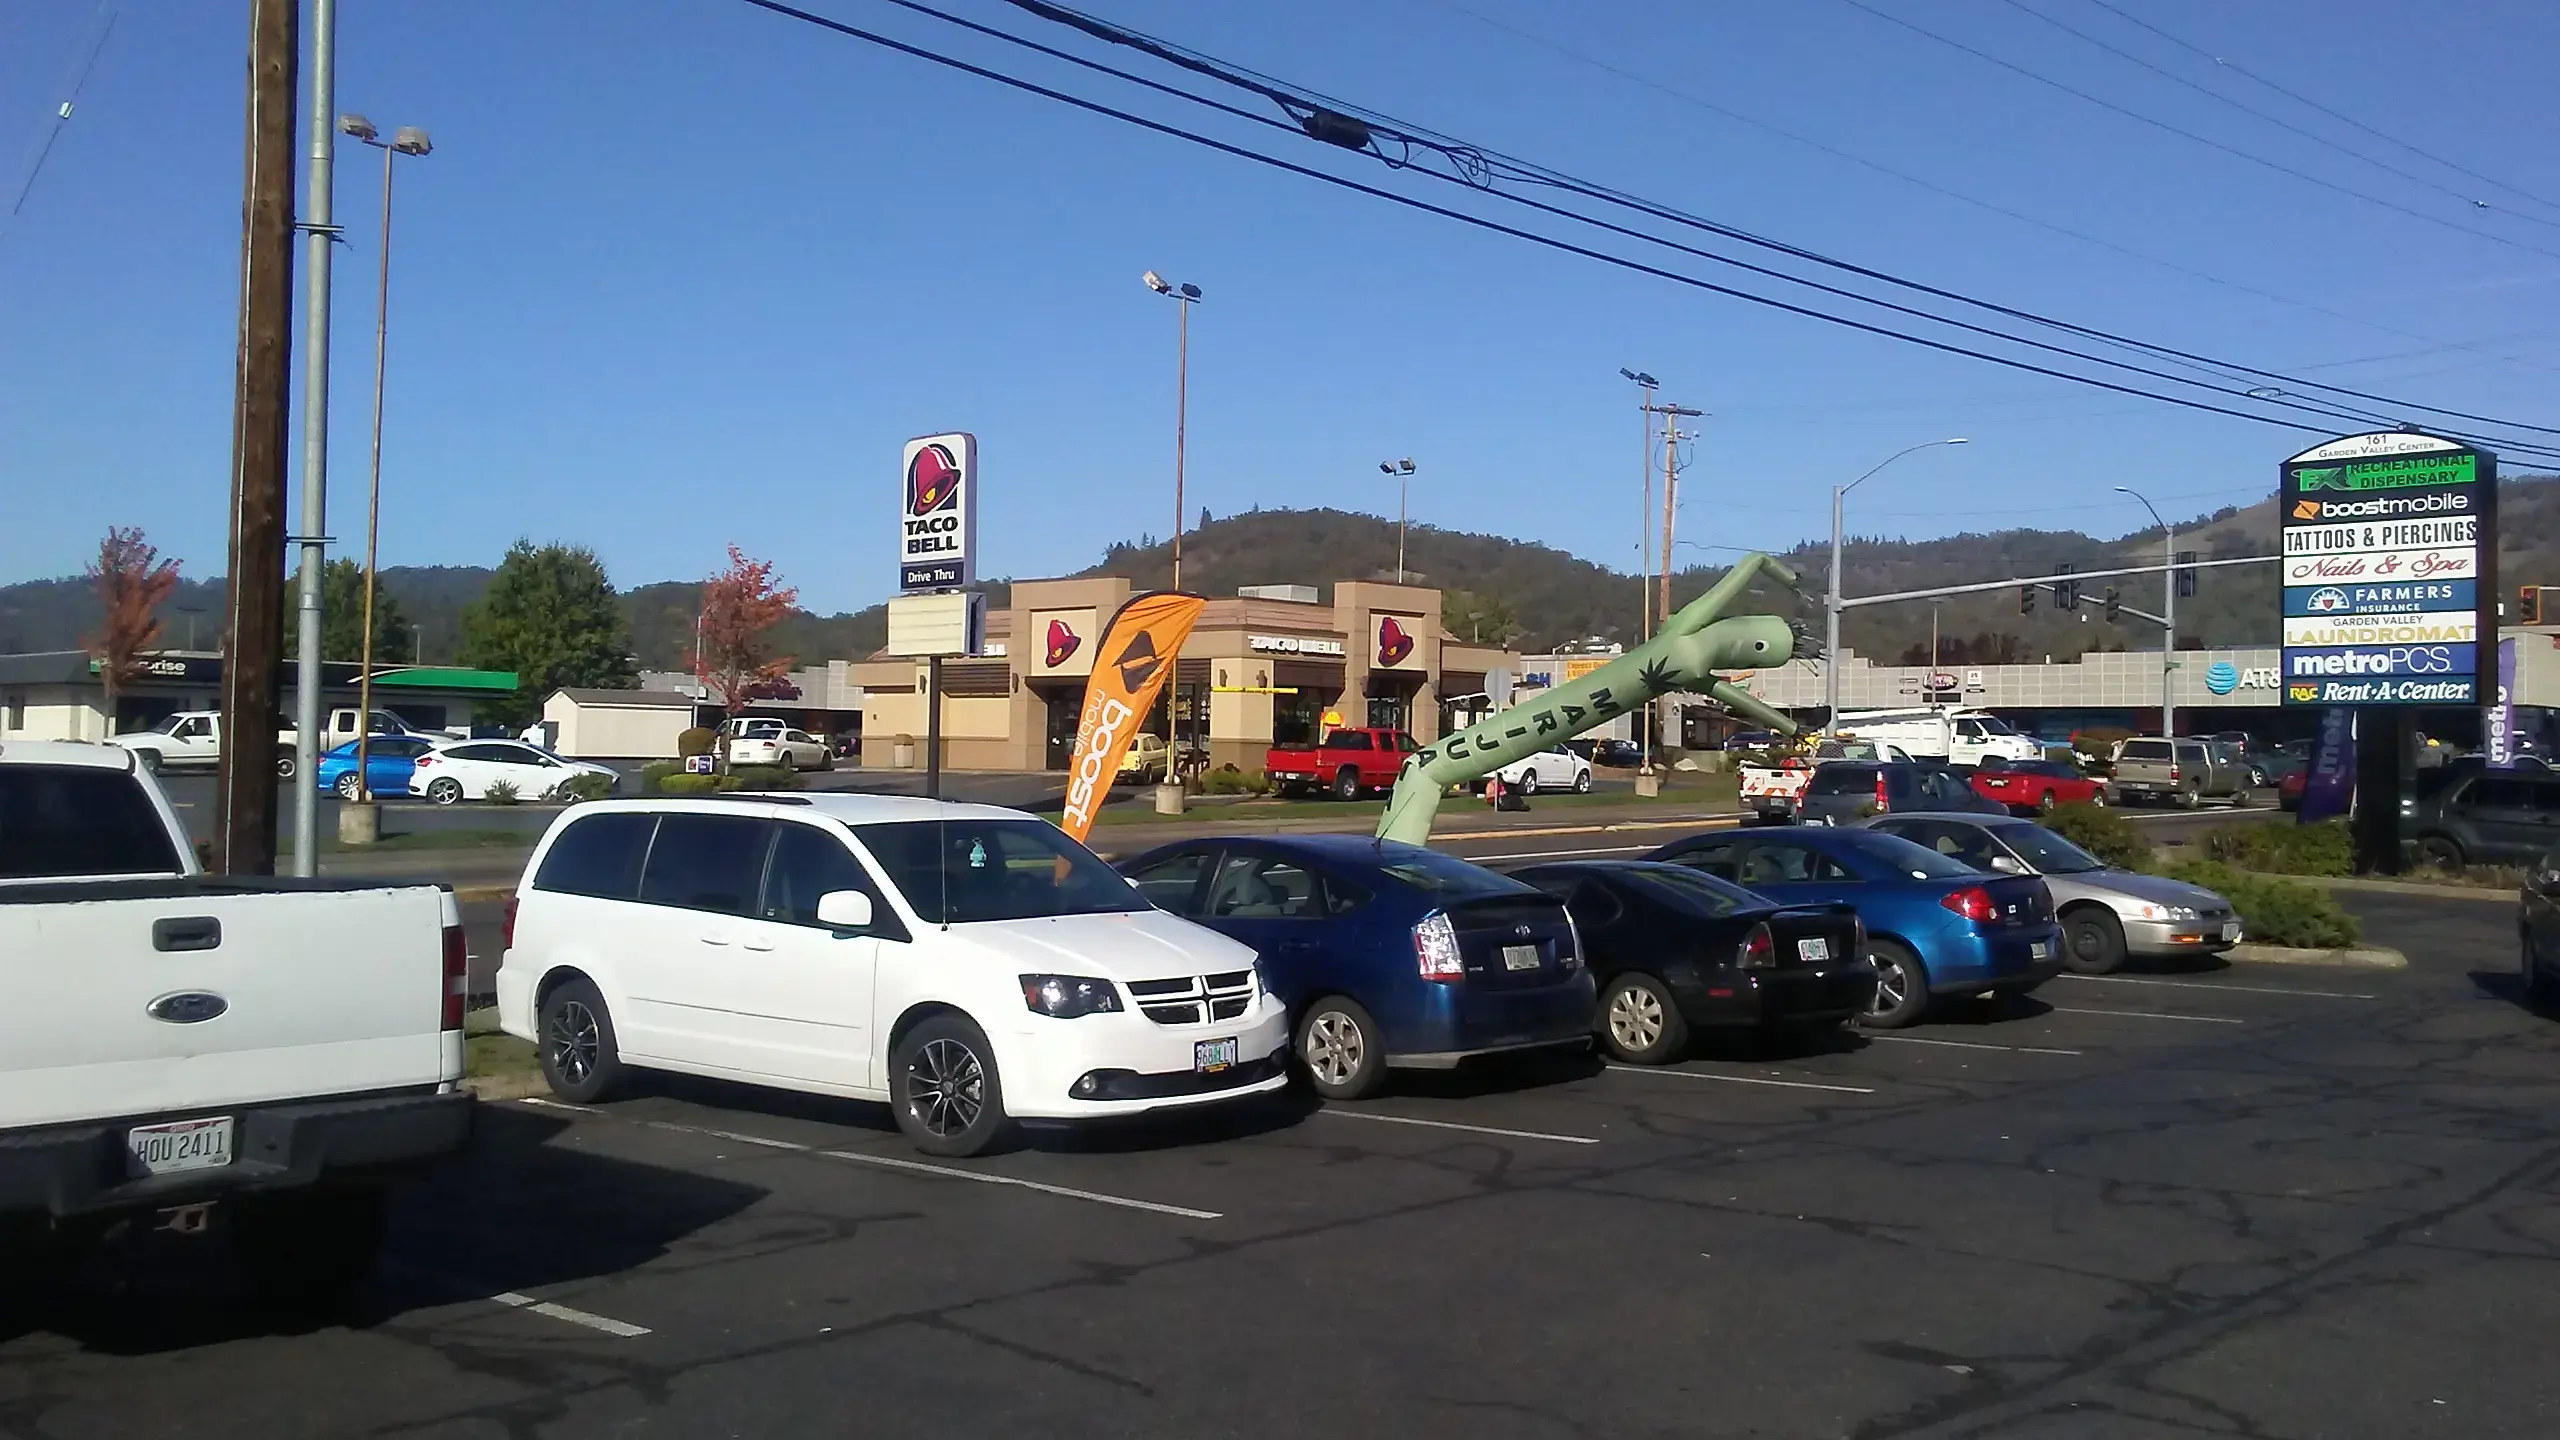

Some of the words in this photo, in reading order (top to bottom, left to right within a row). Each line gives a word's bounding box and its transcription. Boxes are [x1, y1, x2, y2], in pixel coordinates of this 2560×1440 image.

[2366, 434, 2387, 444] 161
[2350, 456, 2470, 475] RECREATIONAL
[2360, 470, 2459, 489] DISPENSARY
[904, 516, 959, 536] TACO
[907, 535, 959, 554] BELL
[2286, 530, 2355, 551] TATTOOS
[2363, 527, 2374, 546] &
[2382, 521, 2477, 545] PIERCINGS
[2292, 558, 2365, 579] Nails
[2374, 554, 2403, 575] &
[2410, 552, 2469, 578] Spa
[907, 571, 931, 583] Drive
[934, 568, 955, 580] Thru
[2356, 585, 2453, 601] FARMERS
[2355, 602, 2420, 613] INSURANCE
[2333, 617, 2379, 627] GARDEN
[2383, 615, 2424, 625] VALLEY
[2286, 625, 2475, 645] LAUNDROMAT
[2290, 687, 2319, 701] RAC
[1074, 688, 1106, 757] mobile
[2488, 686, 2507, 763] metro
[1064, 698, 1133, 828] boost
[137, 1137, 172, 1163] HOU
[178, 1131, 223, 1159] 2411
